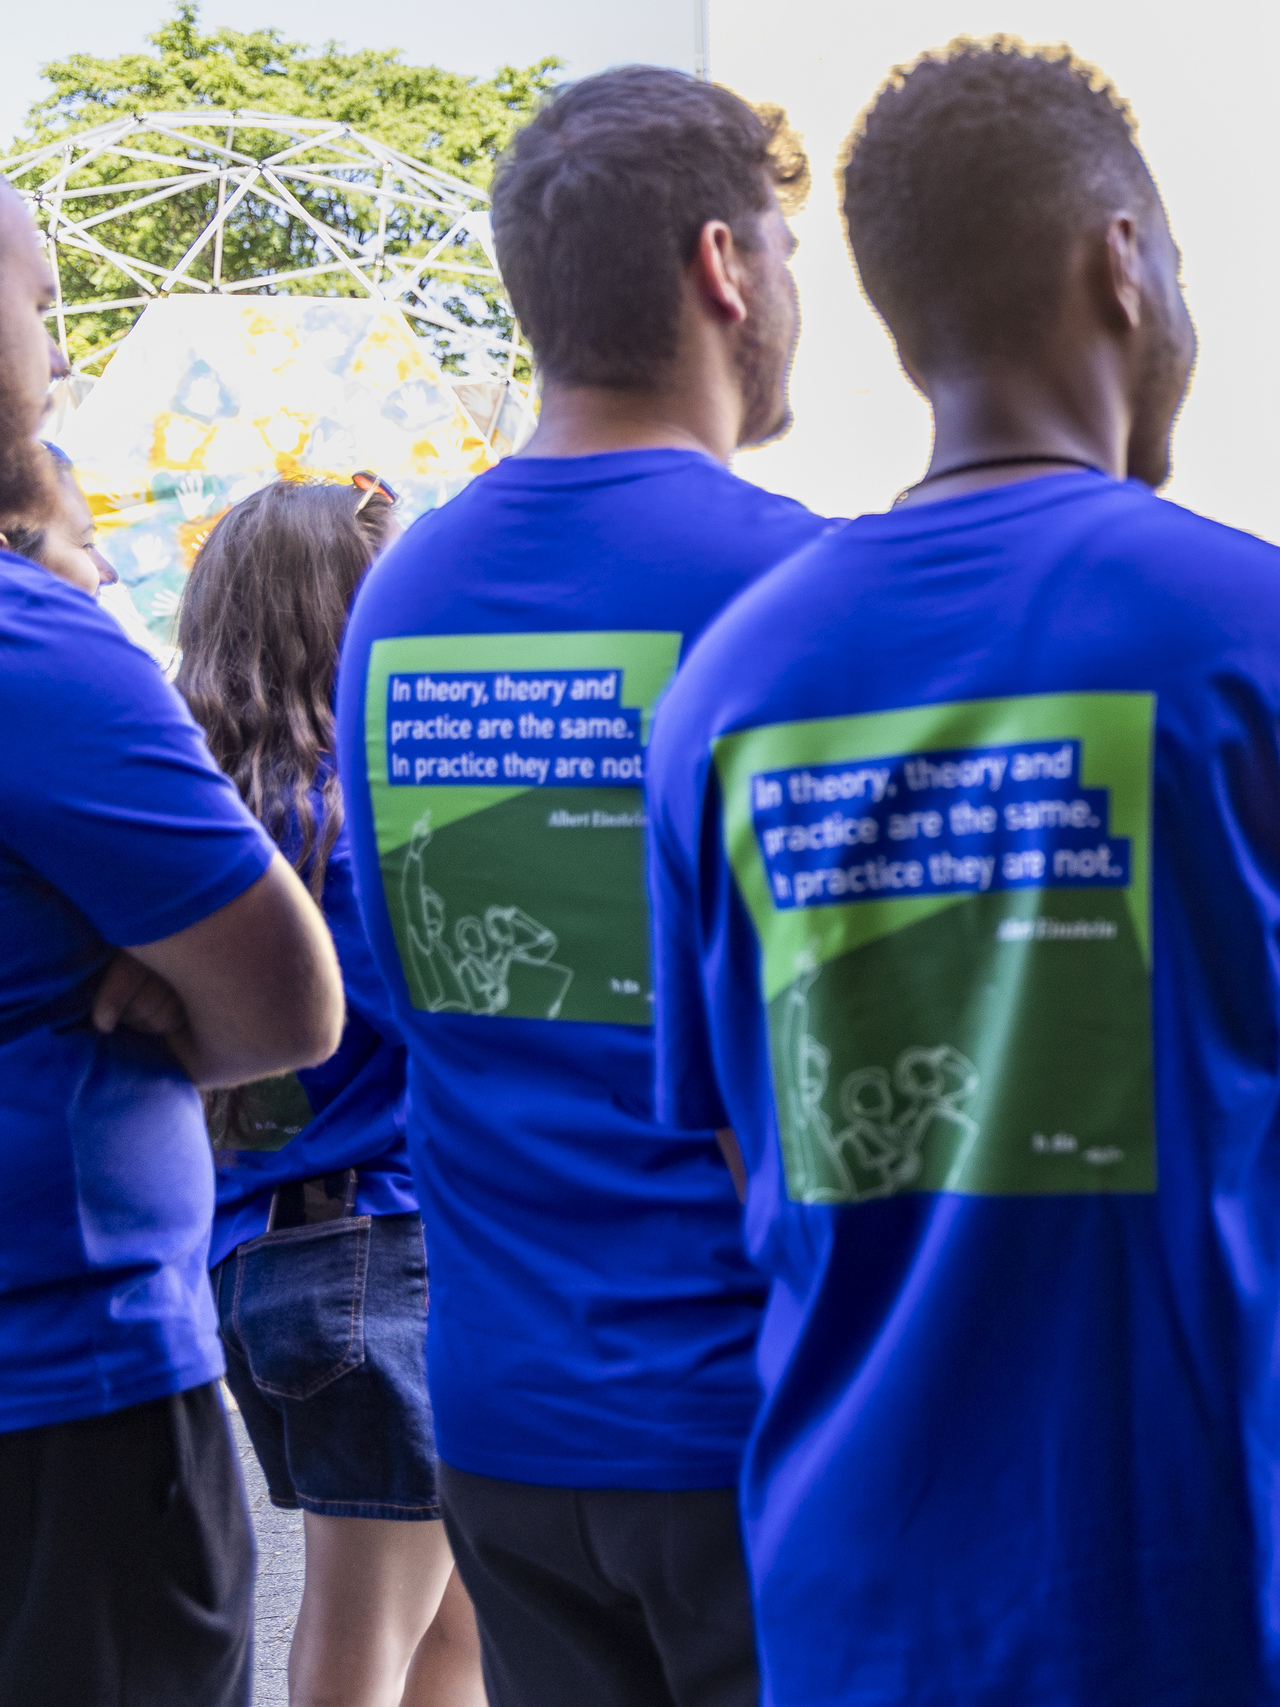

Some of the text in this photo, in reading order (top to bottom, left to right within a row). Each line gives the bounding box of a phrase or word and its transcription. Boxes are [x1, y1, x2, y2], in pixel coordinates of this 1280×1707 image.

[392, 672, 617, 708] In theory, theory and
[391, 712, 634, 746] practice are the same.
[392, 752, 410, 777] In
[415, 751, 499, 784] practice
[503, 752, 549, 784] they
[555, 757, 595, 778] are
[904, 757, 1008, 792] theory
[1010, 744, 1074, 782] and
[888, 810, 943, 839] are
[950, 799, 998, 836] the
[1003, 799, 1101, 832] same.
[793, 854, 924, 907] practice
[929, 851, 996, 892] they
[1002, 849, 1046, 881] are
[1053, 843, 1123, 878] not.
